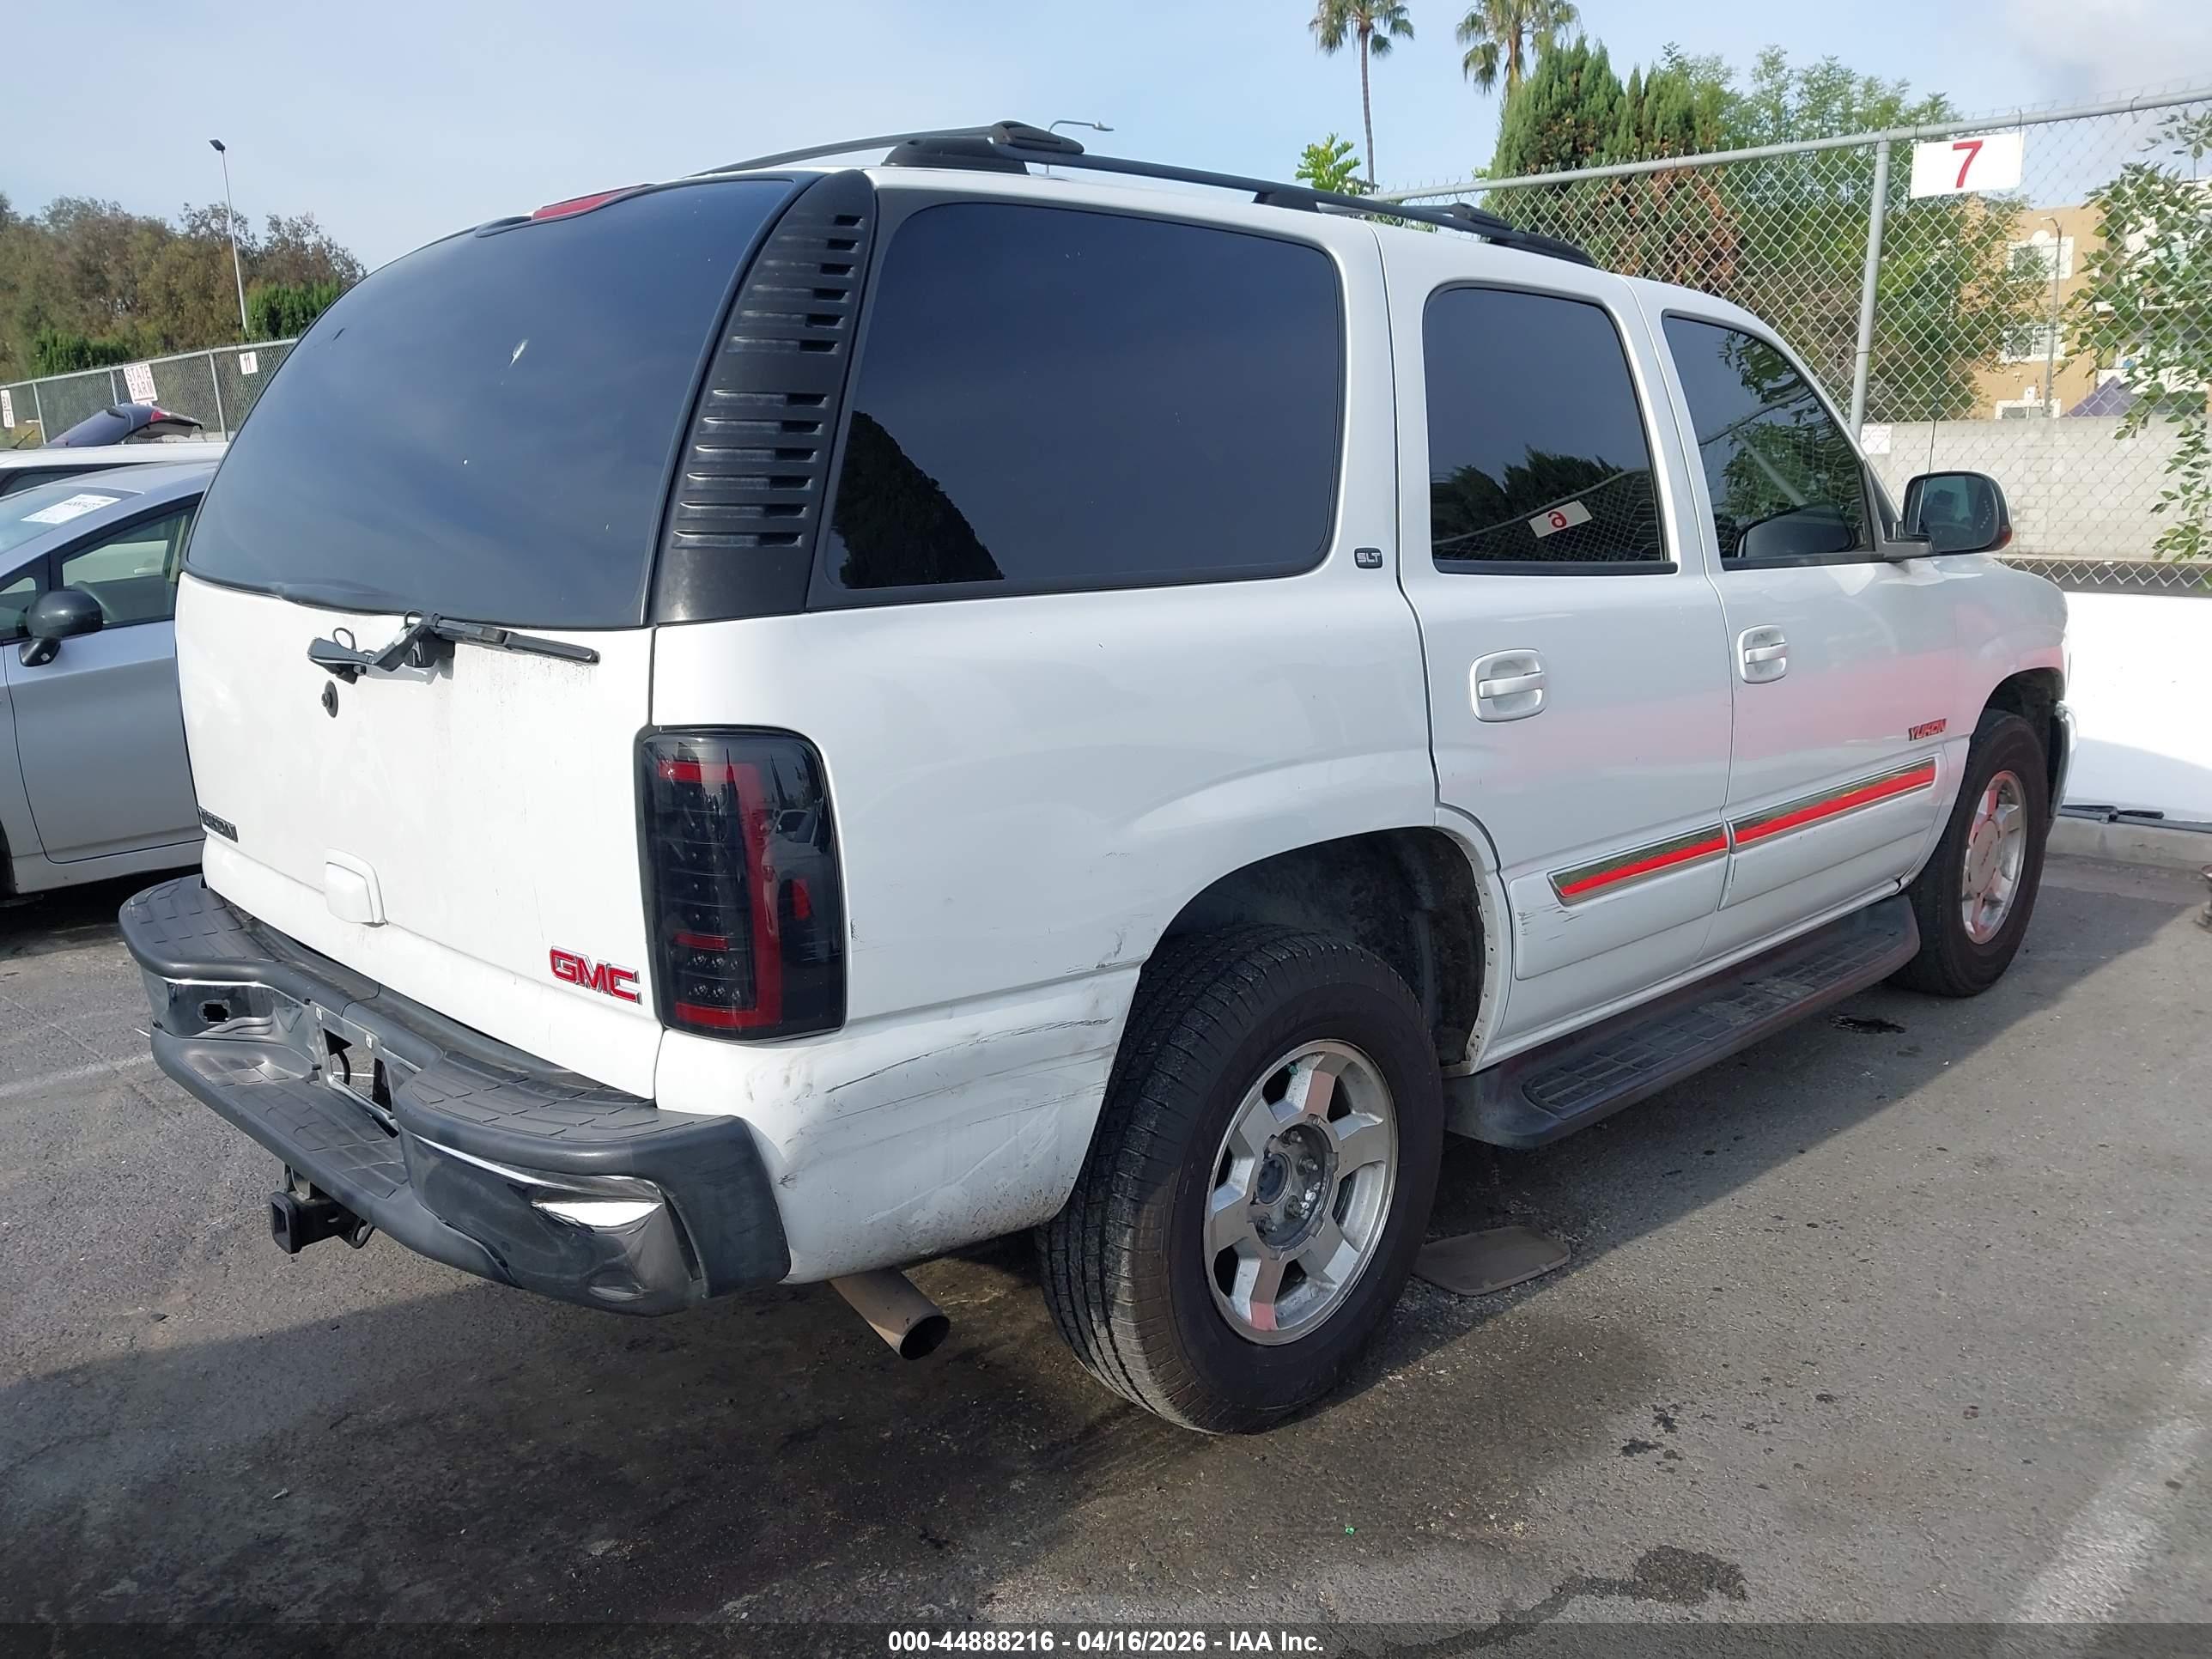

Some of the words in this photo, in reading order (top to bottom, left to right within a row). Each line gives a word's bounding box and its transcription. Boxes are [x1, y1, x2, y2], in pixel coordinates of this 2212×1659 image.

[1952, 140, 1984, 188] 7
[244, 353, 252, 372] 11
[126, 365, 151, 383] STATE
[131, 380, 154, 397] FARM
[1357, 552, 1381, 563] SLT
[1908, 718, 1947, 741] YUKON
[550, 945, 642, 1006] GMC
